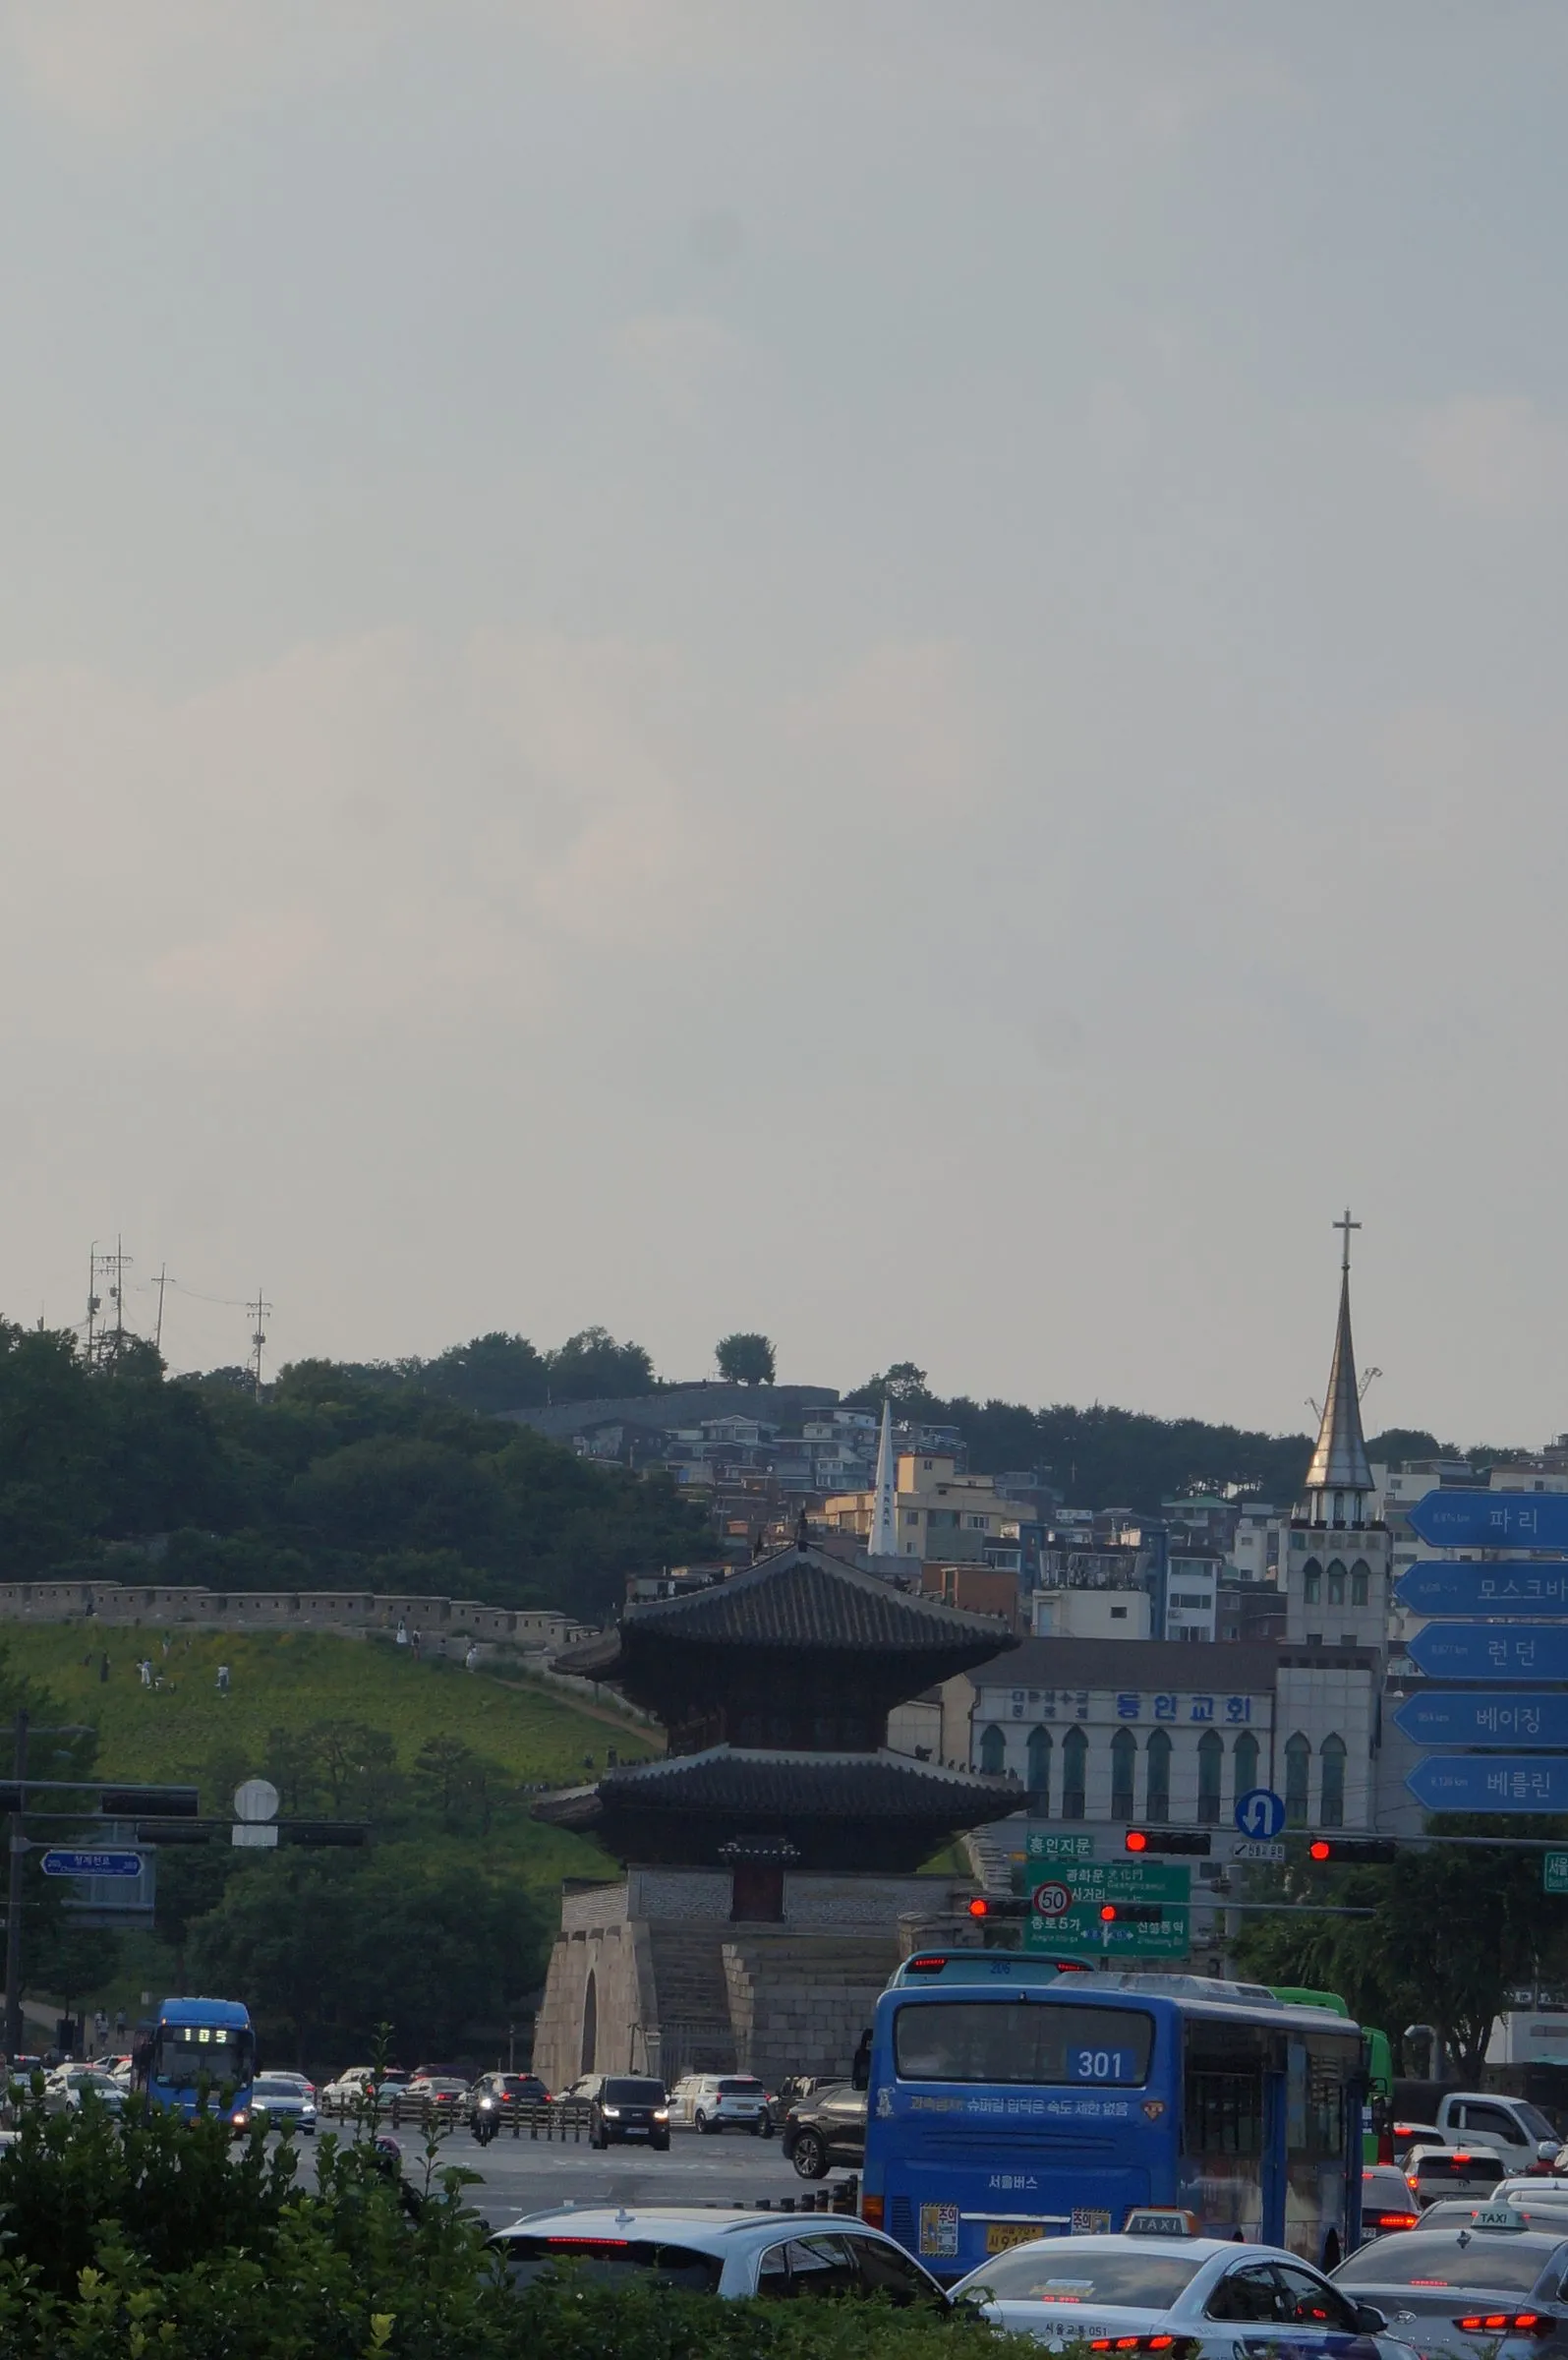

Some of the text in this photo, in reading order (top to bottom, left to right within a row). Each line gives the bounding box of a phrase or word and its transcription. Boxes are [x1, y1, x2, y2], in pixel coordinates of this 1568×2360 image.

[1489, 1508, 1538, 1534] 파리
[1477, 1576, 1568, 1602] 모스크바
[1488, 1638, 1536, 1666] 런던
[1477, 1707, 1540, 1734] 베이징
[1487, 1771, 1550, 1798] 베를린
[1030, 1837, 1091, 1855] 흥인지문
[1067, 1869, 1104, 1883] 광화문
[1042, 1891, 1064, 1910] 50
[1073, 1887, 1106, 1901] 사거리
[1031, 1918, 1080, 1931] 종로5가
[184, 2029, 227, 2043] 105
[1077, 2051, 1122, 2078] 301
[1047, 2098, 1074, 2116] 속도
[1075, 2099, 1101, 2116] 제한
[1103, 2100, 1130, 2117] 없음
[989, 2175, 1038, 2190] 서울버스
[938, 2208, 957, 2224] 주의
[1074, 2212, 1091, 2229] 주의
[1137, 2217, 1178, 2231] TAXI
[1481, 2213, 1507, 2224] TAXI
[1088, 2327, 1108, 2337] 051
